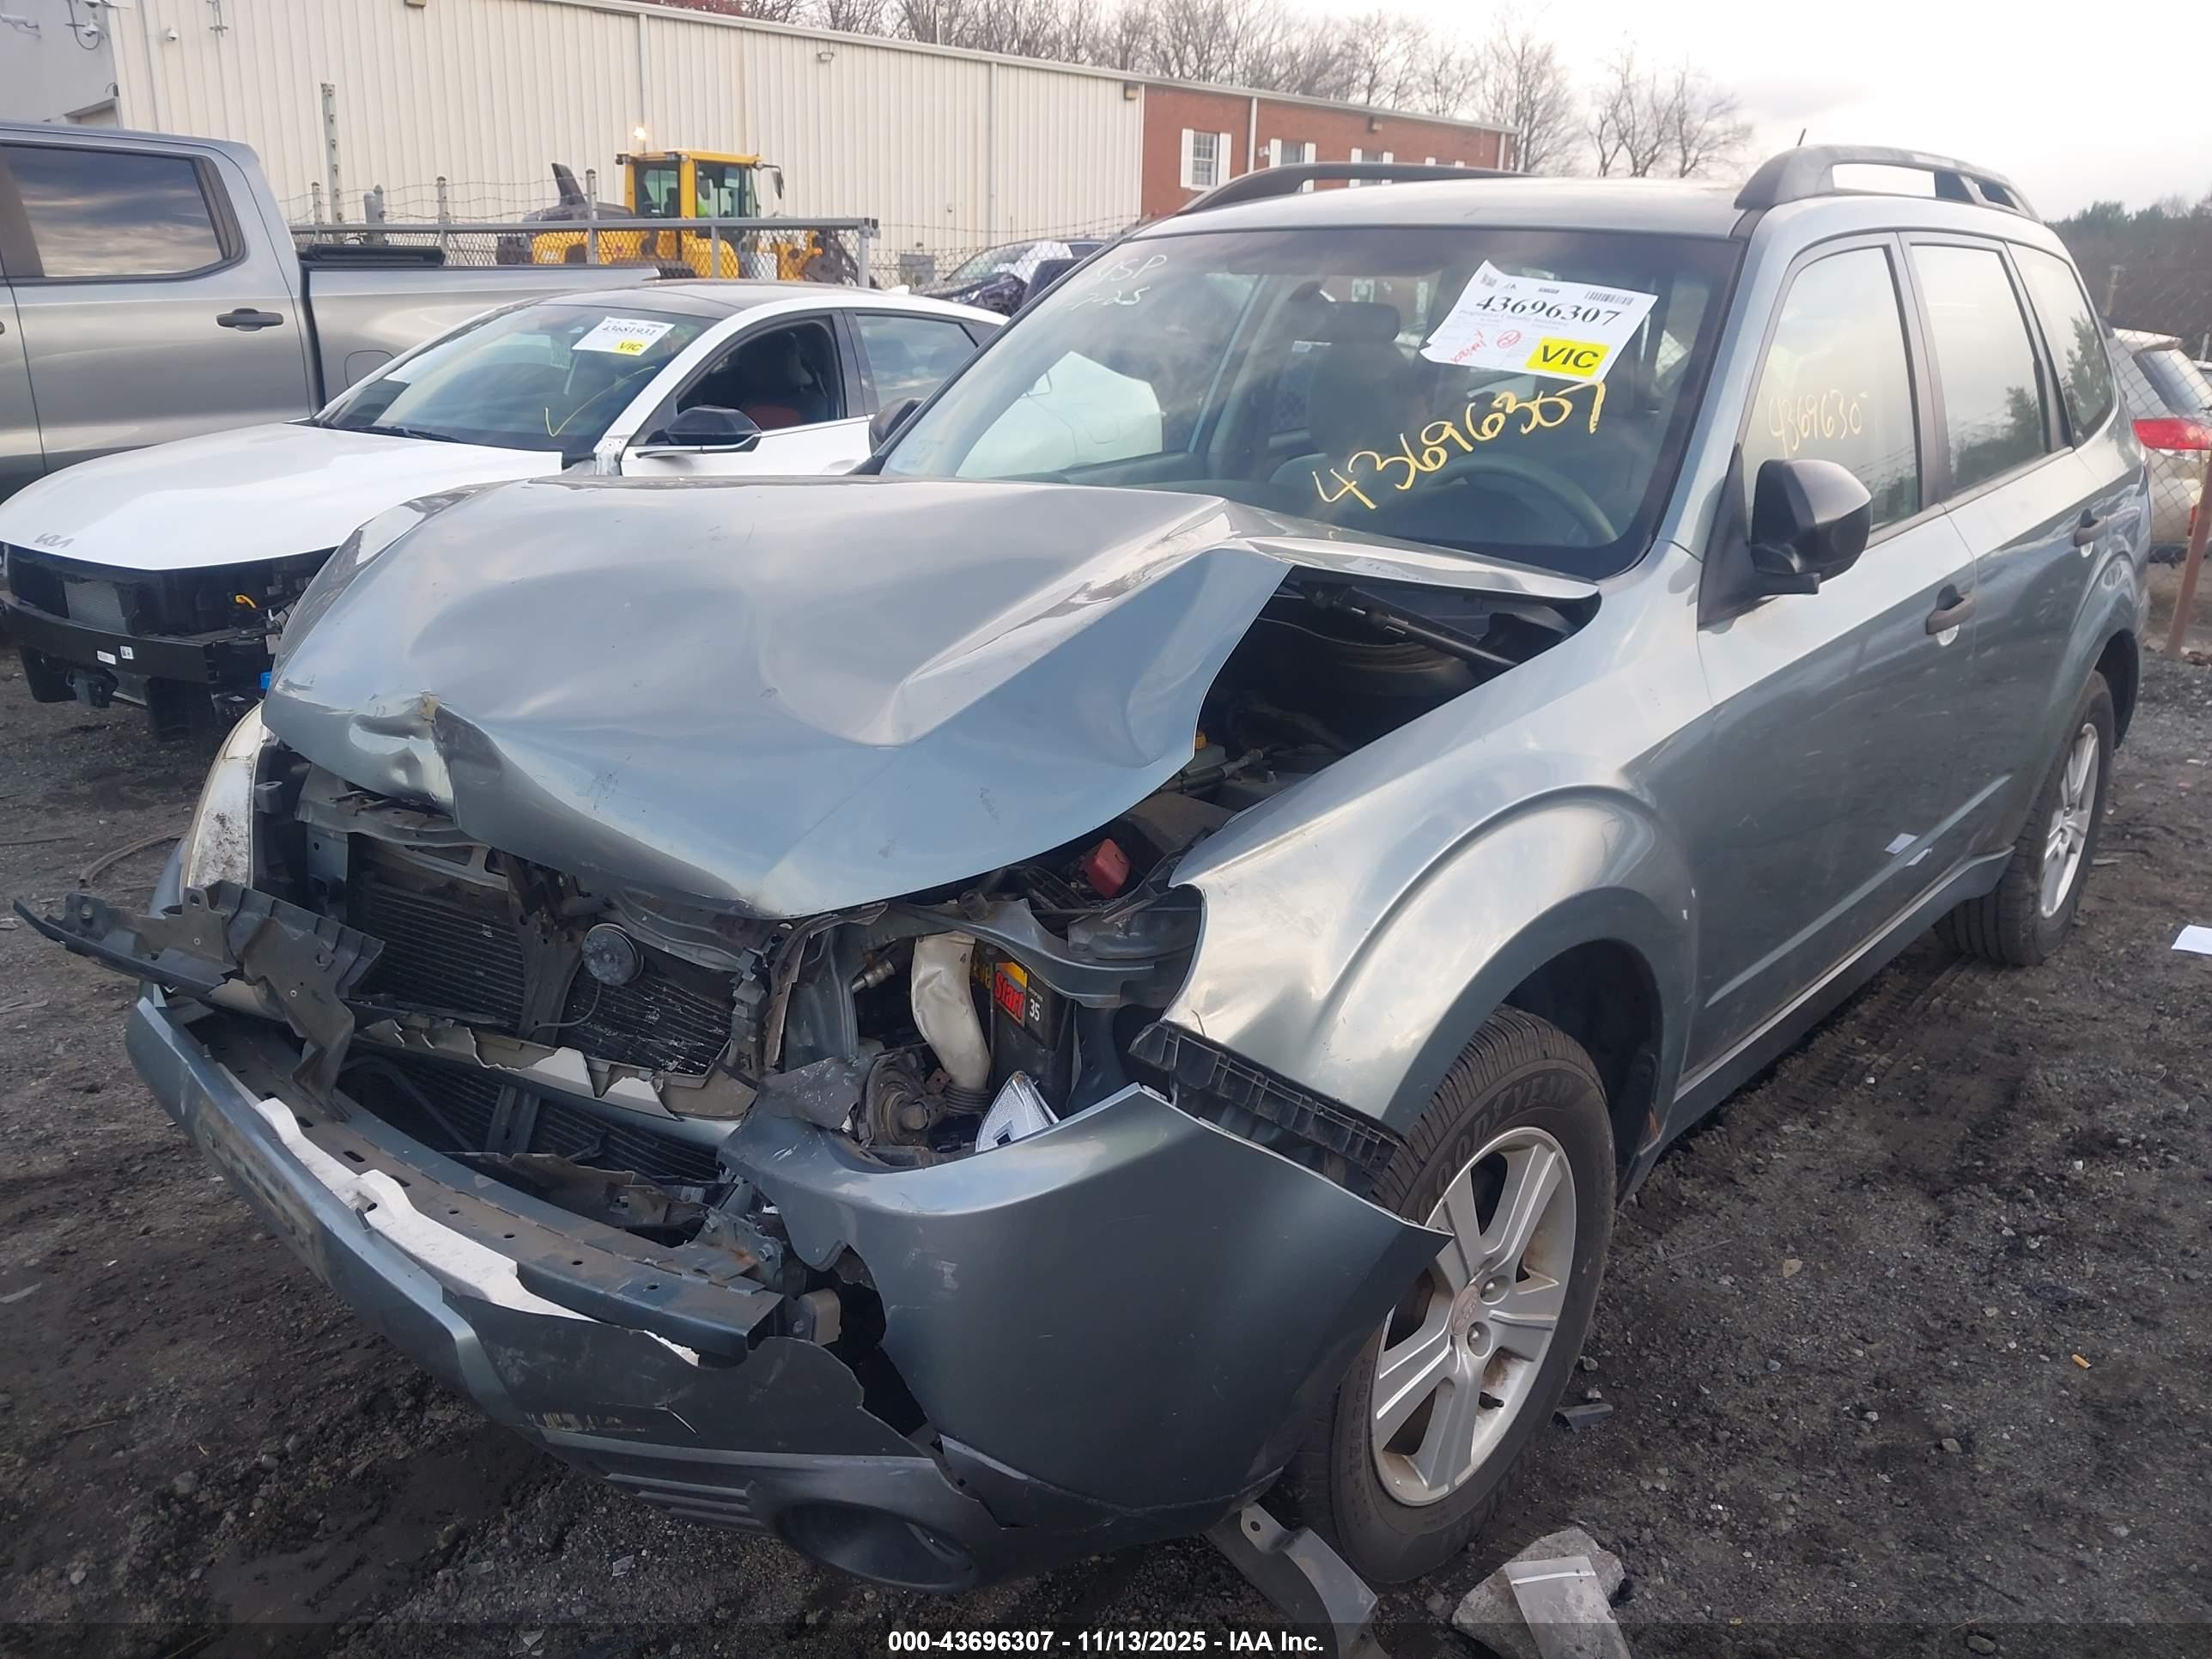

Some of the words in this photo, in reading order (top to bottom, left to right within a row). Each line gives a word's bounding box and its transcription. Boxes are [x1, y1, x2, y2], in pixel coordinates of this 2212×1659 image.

[1475, 294, 1625, 326] 43696307
[619, 341, 644, 352] VIC
[1540, 344, 1599, 369] VIC
[1767, 388, 1869, 459] 4369630
[1311, 380, 1607, 510] 43696307
[994, 969, 1025, 1019] Start
[1029, 998, 1042, 1022] 35
